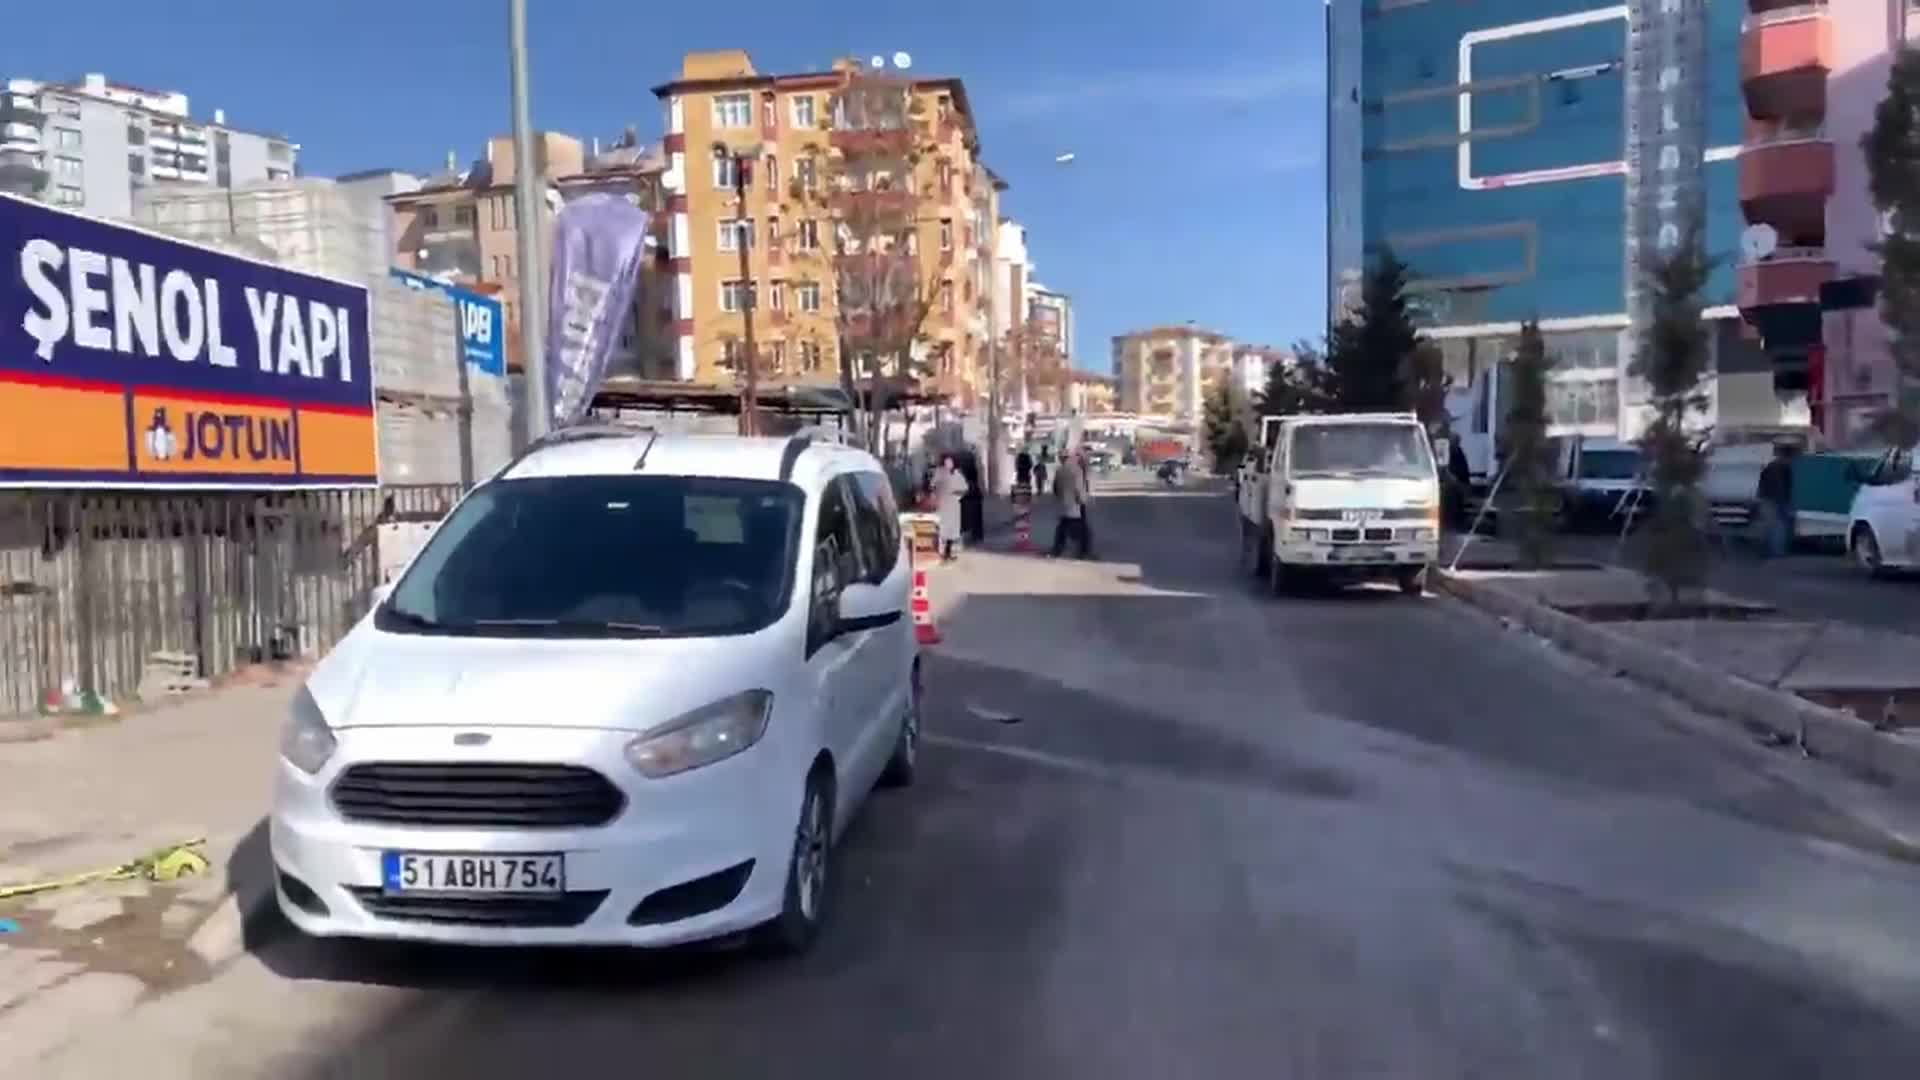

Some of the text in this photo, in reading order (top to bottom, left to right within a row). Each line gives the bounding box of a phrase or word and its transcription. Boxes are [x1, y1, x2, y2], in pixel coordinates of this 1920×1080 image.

[20, 238, 352, 382] ŞENOL YAPI
[183, 411, 291, 461] JOTUN
